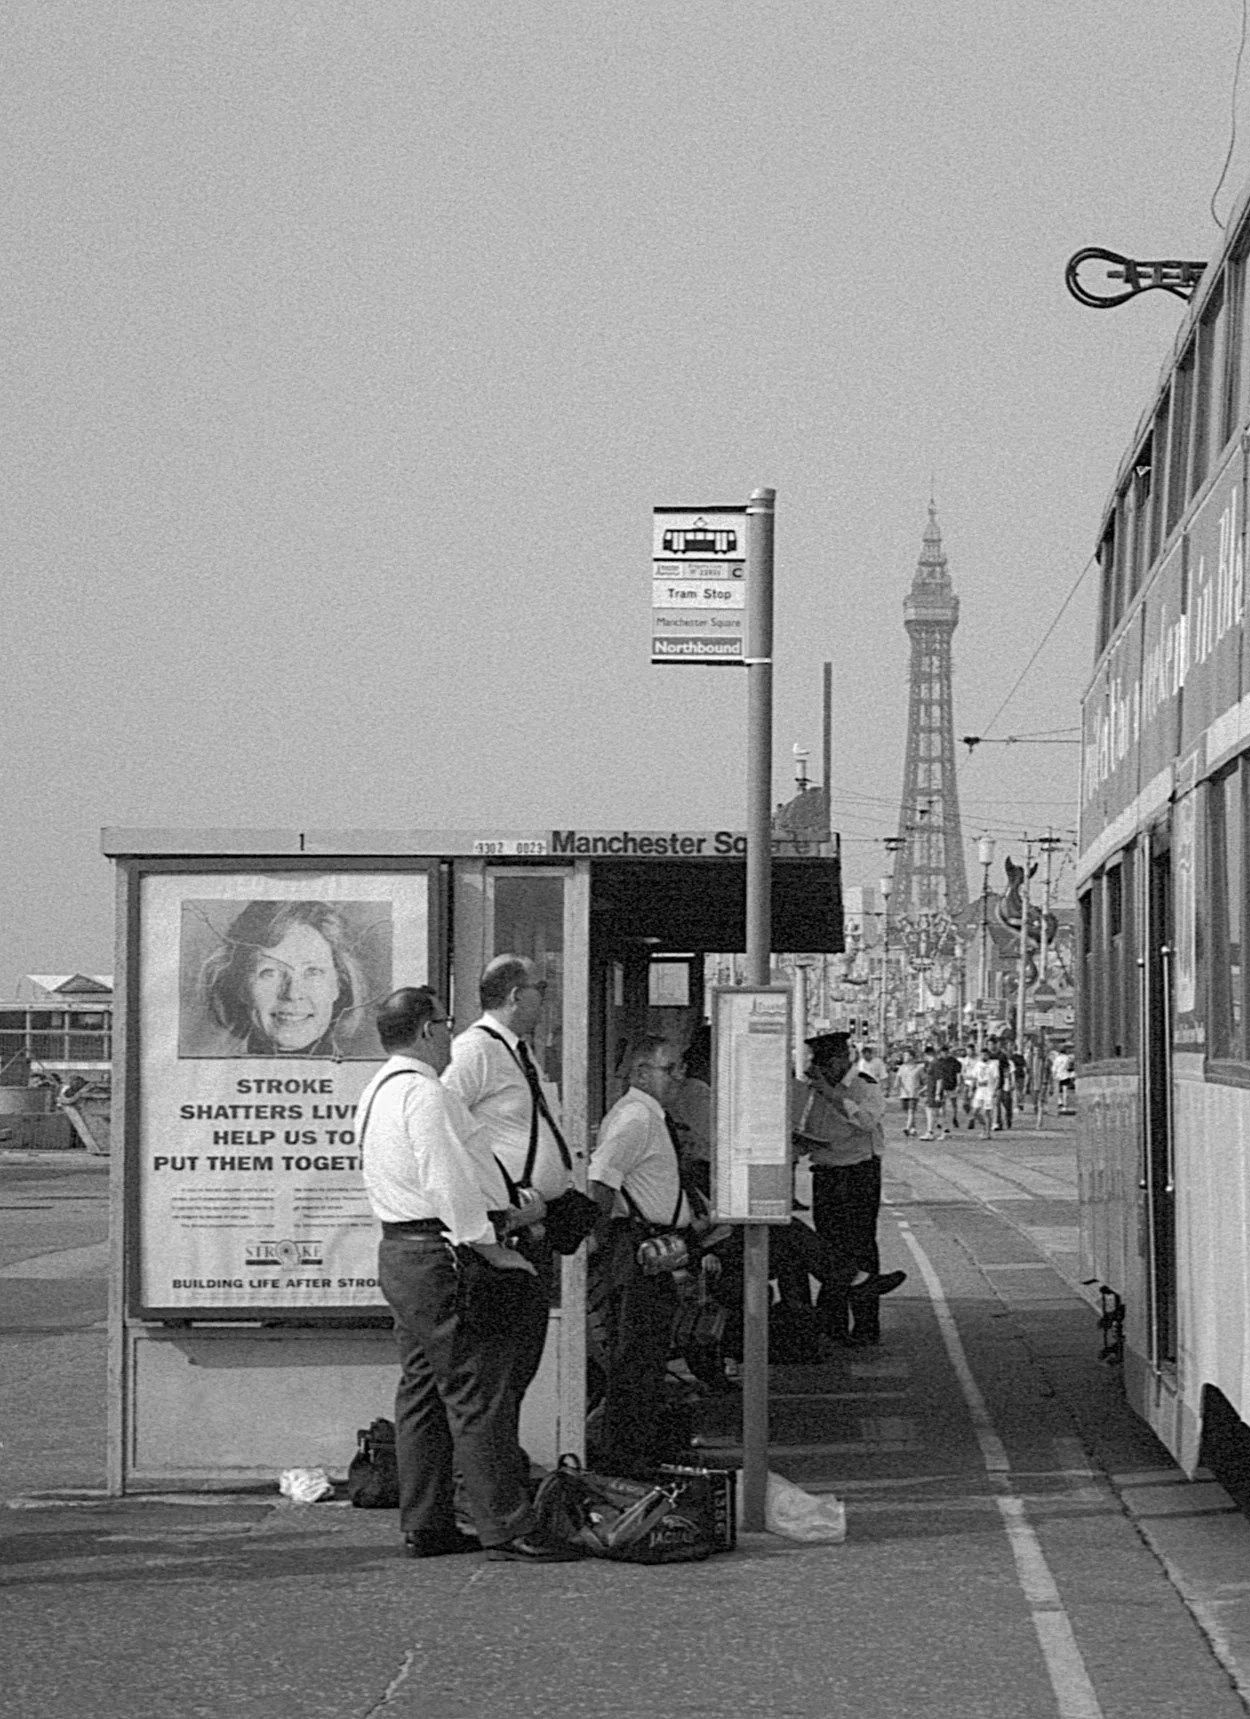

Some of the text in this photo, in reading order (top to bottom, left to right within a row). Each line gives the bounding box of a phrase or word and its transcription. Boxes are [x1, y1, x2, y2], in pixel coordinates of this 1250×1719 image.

[732, 567, 743, 578] C
[668, 588, 732, 600] Tram Stop
[656, 617, 741, 628] Manchester Square
[655, 640, 740, 654] Northbound
[552, 831, 706, 855] Manchester
[237, 1079, 333, 1094] STROKE
[180, 1104, 302, 1120] SHATTERS
[213, 1130, 355, 1145] HELP US TO
[154, 1156, 198, 1171] PUT
[207, 1156, 273, 1171] THEM
[172, 1279, 243, 1289] BUILDING
[249, 1279, 280, 1289] LIFE
[286, 1279, 331, 1288] AFTER
